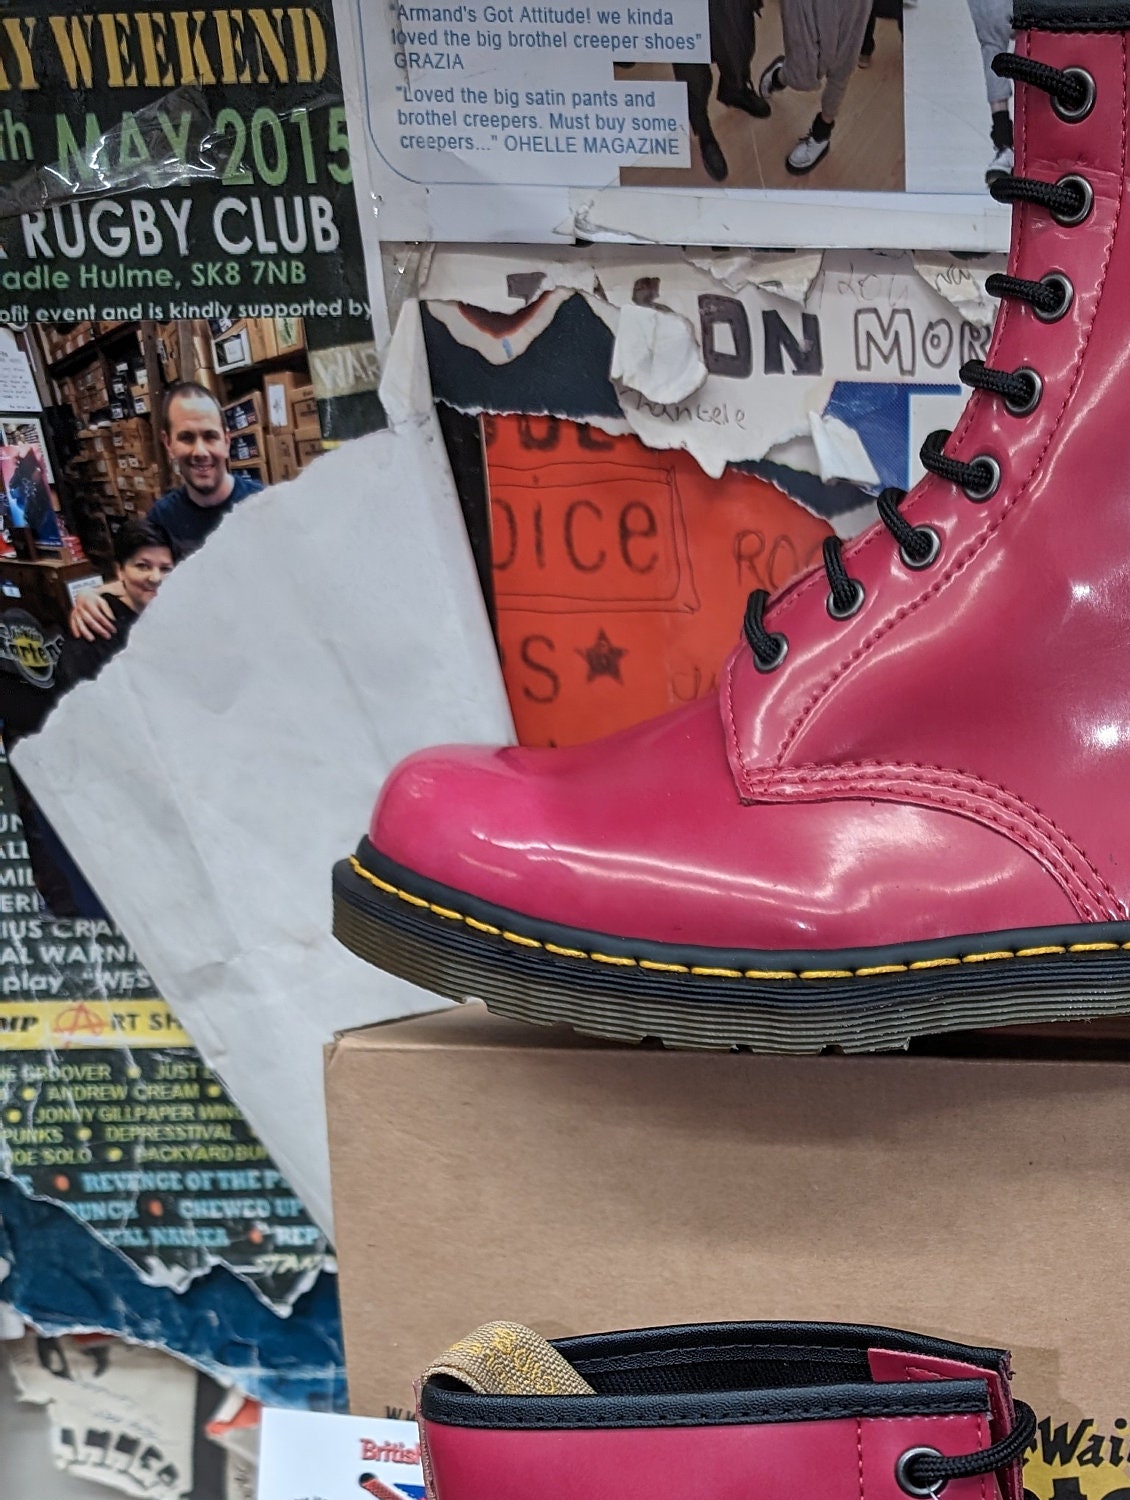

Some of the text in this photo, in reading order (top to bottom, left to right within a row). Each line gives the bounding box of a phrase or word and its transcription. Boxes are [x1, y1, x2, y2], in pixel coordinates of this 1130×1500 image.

[390, 4, 674, 26] "Armand's Got Attitude! we kinda
[49, 8, 328, 89] WEEKEND
[391, 28, 702, 52] loved the big brothel creeper shoes"
[394, 53, 464, 70] GRAZIA
[396, 86, 656, 110] "Loved the big satin pants and
[397, 109, 678, 134] brothel creepers. Must buy some
[55, 110, 192, 188] MAY
[214, 107, 353, 188] 2015
[504, 136, 577, 153] OHELLE
[583, 137, 680, 156] MAGAZINE
[20, 195, 341, 259] RUGBY CLUB
[79, 263, 182, 291] Hulme,
[190, 262, 242, 287] SK8
[252, 260, 308, 286] 7NB
[36, 305, 97, 324] event
[102, 301, 143, 321] and
[148, 301, 165, 320] is
[169, 300, 234, 324] kindly
[238, 299, 343, 324] supported
[2, 972, 64, 995] play
